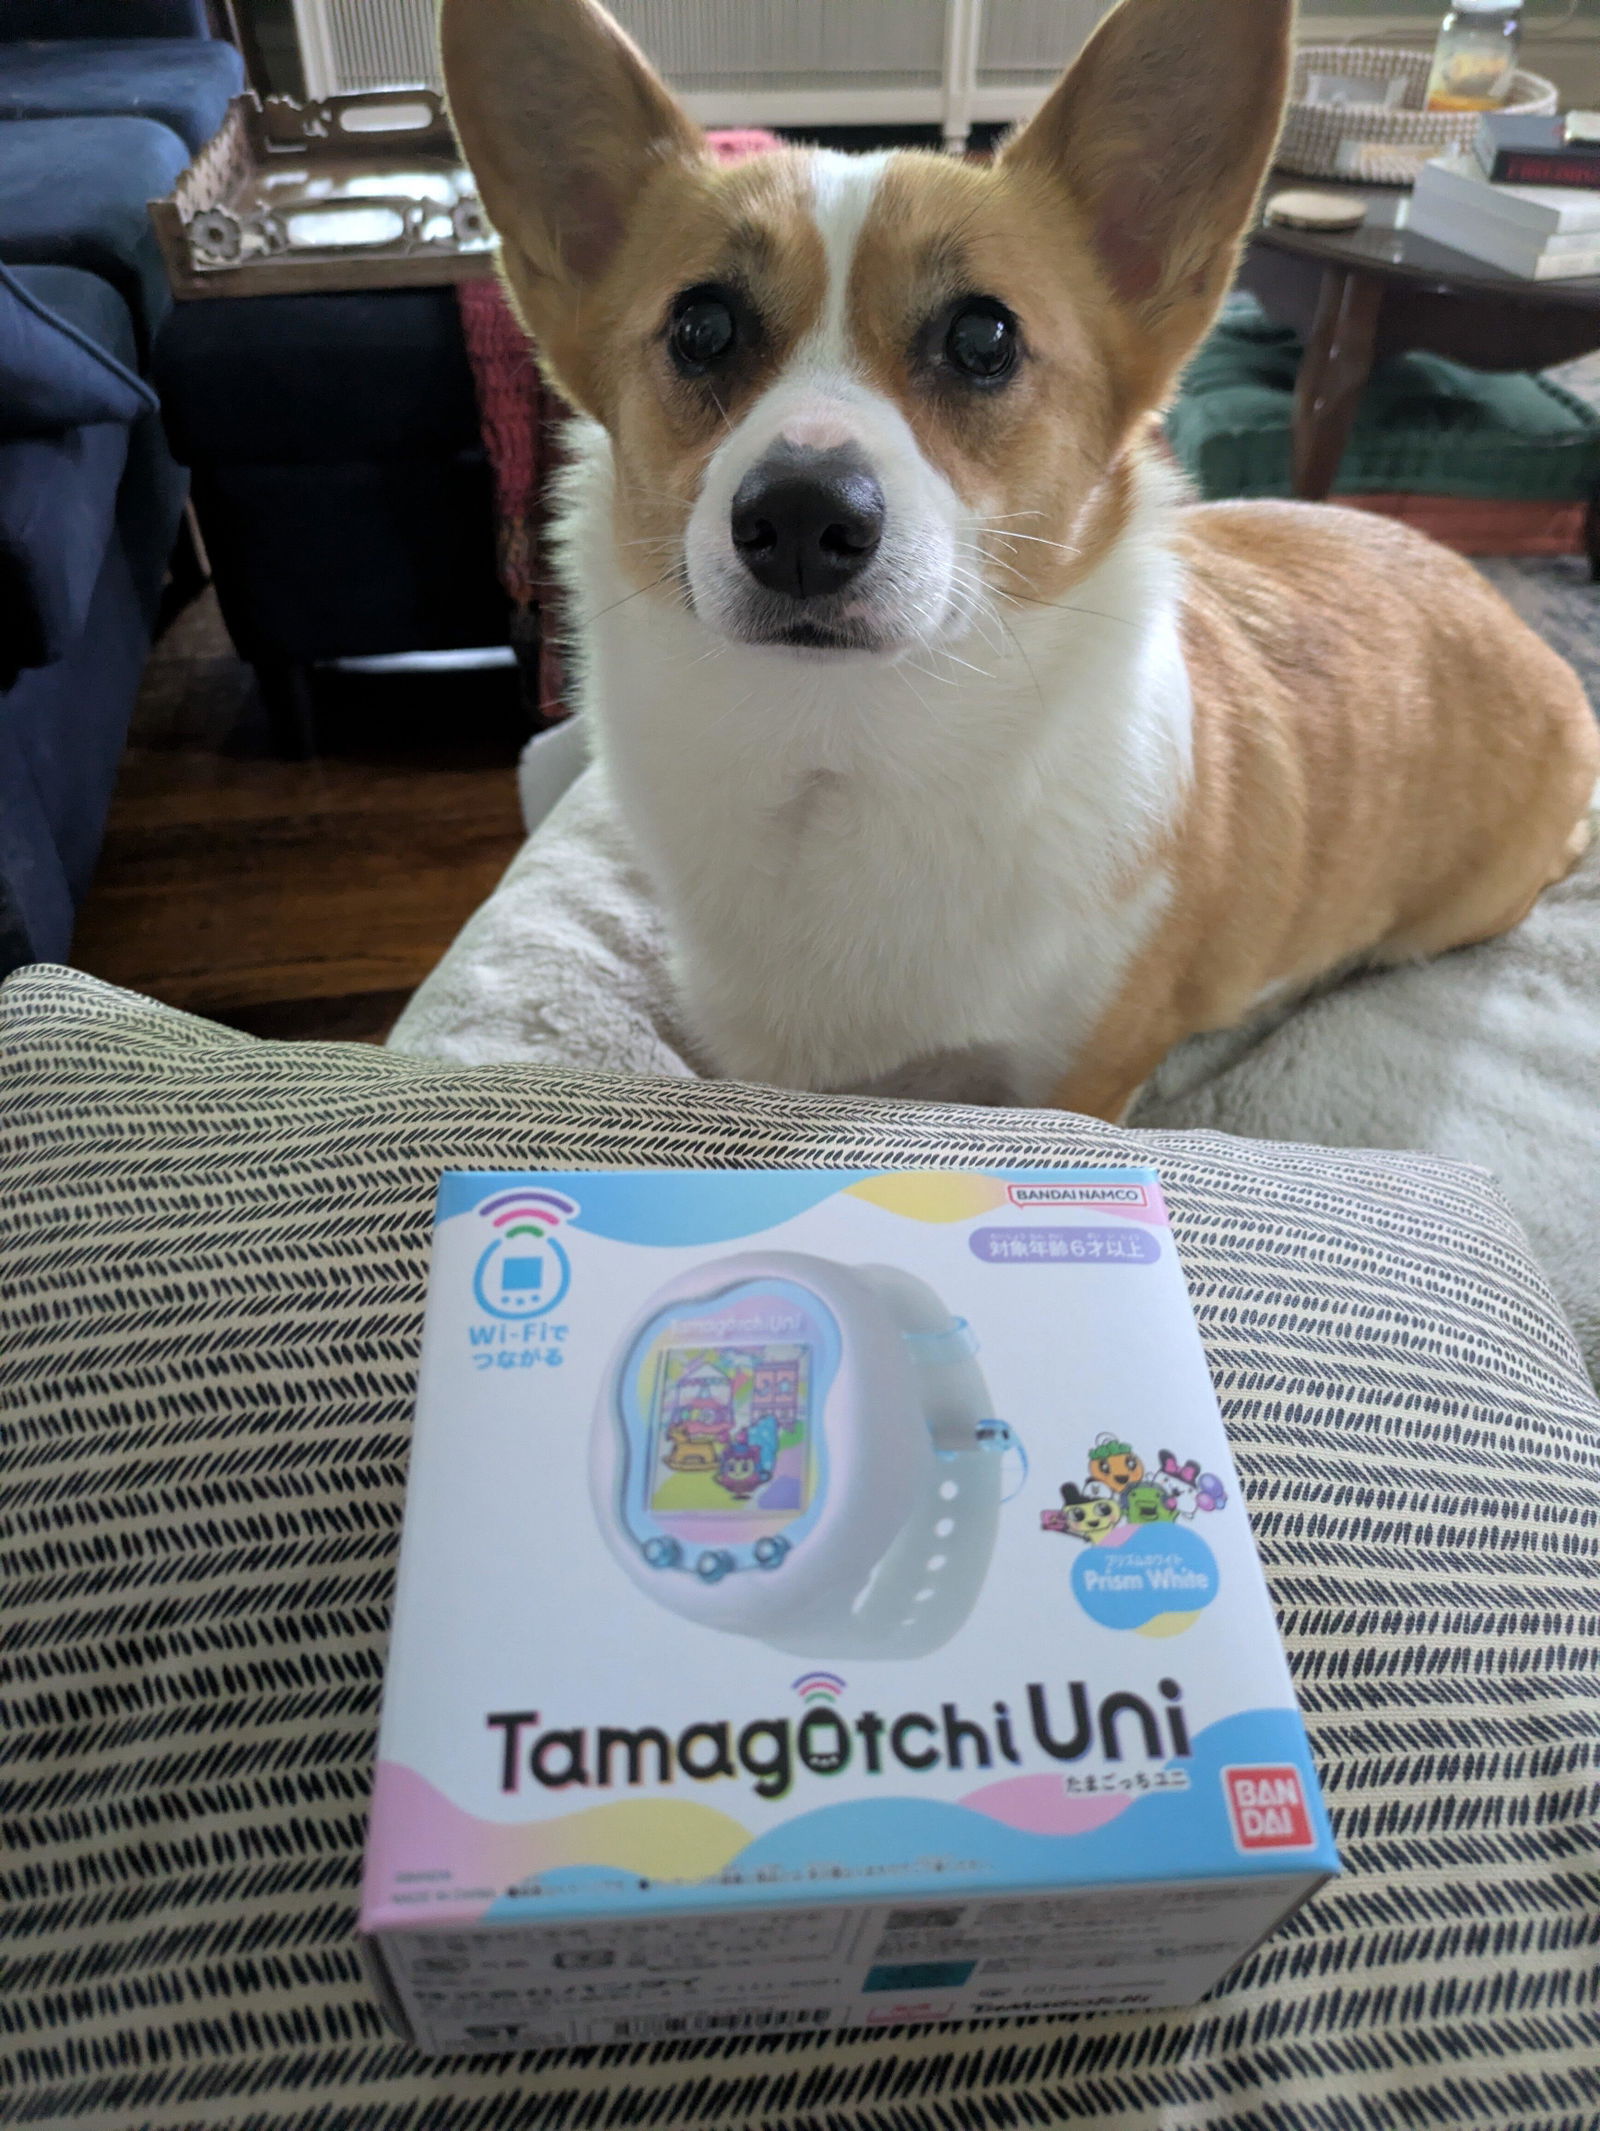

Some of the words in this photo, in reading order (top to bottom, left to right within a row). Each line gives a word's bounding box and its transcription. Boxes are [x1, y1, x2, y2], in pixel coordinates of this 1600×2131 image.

[1016, 1189, 1075, 1201] BANDAI
[1080, 1189, 1138, 1201] NAMCO
[472, 1348, 564, 1370] つながる
[1084, 1570, 1143, 1591] Prism
[1147, 1568, 1208, 1589] White
[1026, 1677, 1192, 1762] Uni
[1067, 1771, 1187, 1793] たまごっちユニ
[1234, 1778, 1299, 1807] BAN
[1242, 1807, 1295, 1838] DAI
